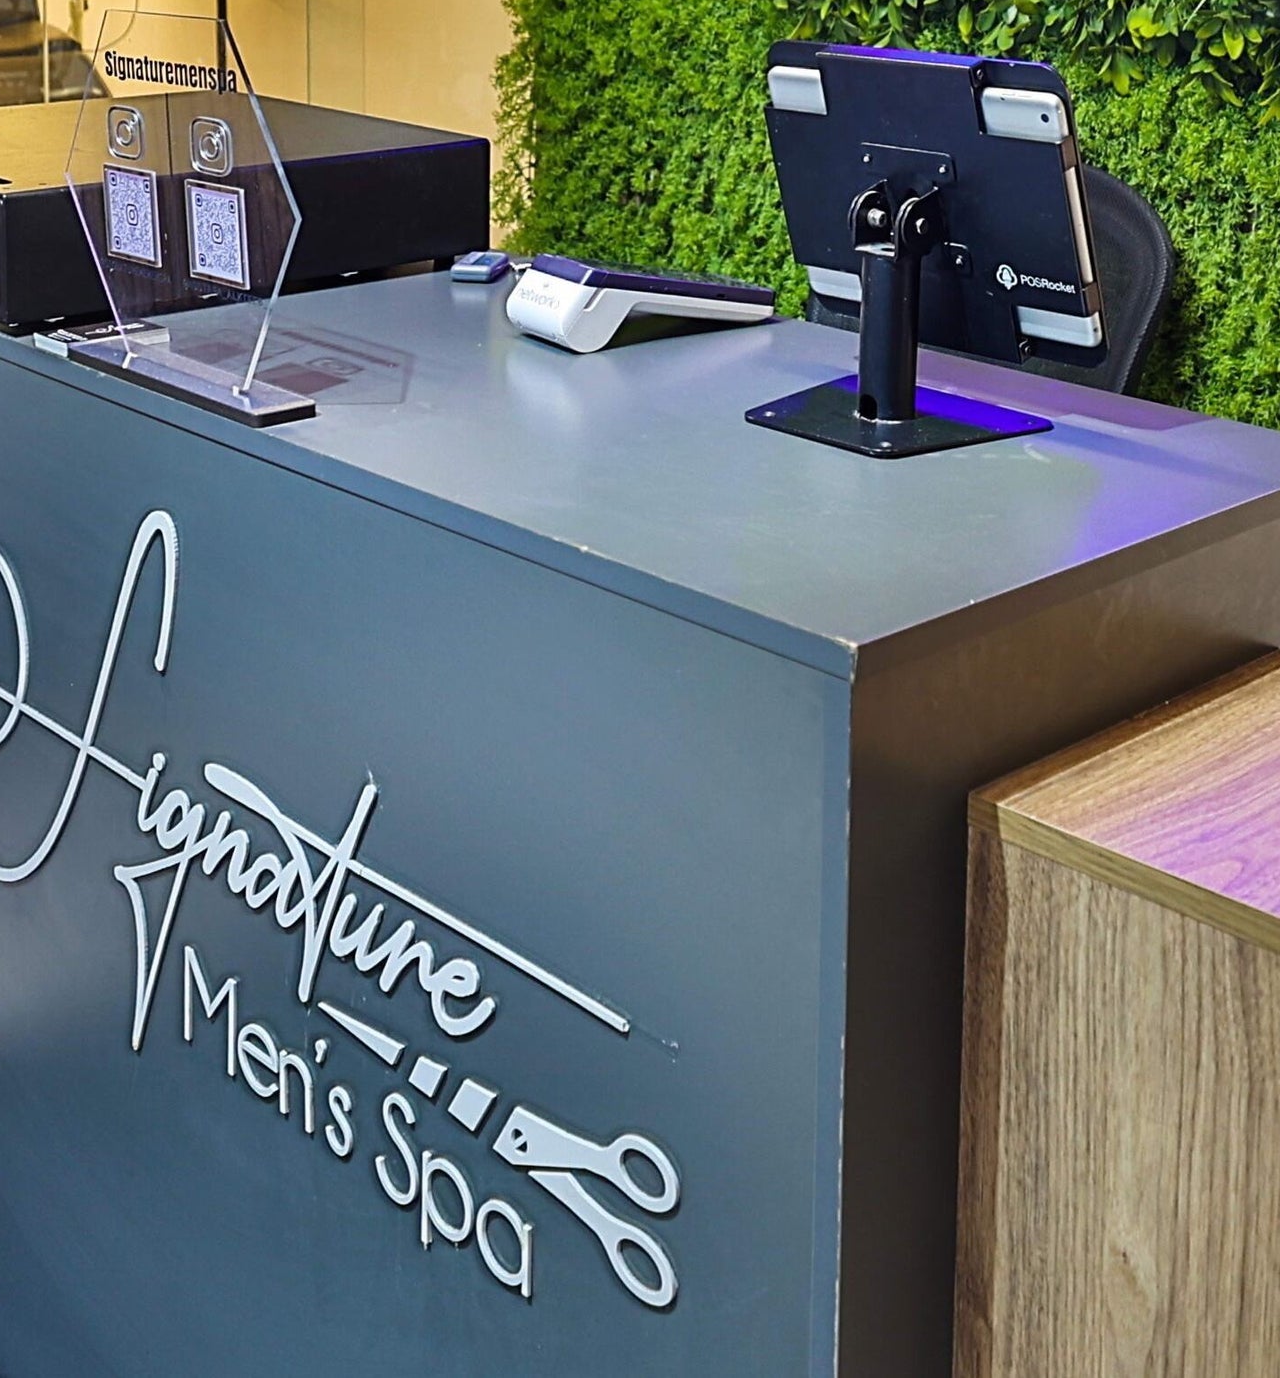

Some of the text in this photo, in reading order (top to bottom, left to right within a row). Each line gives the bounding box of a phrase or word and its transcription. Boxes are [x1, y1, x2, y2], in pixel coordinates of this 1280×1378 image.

[104, 50, 237, 95] Signaturemenspa
[1020, 274, 1076, 294] POSRocket
[182, 945, 532, 1299] Men's Spa
